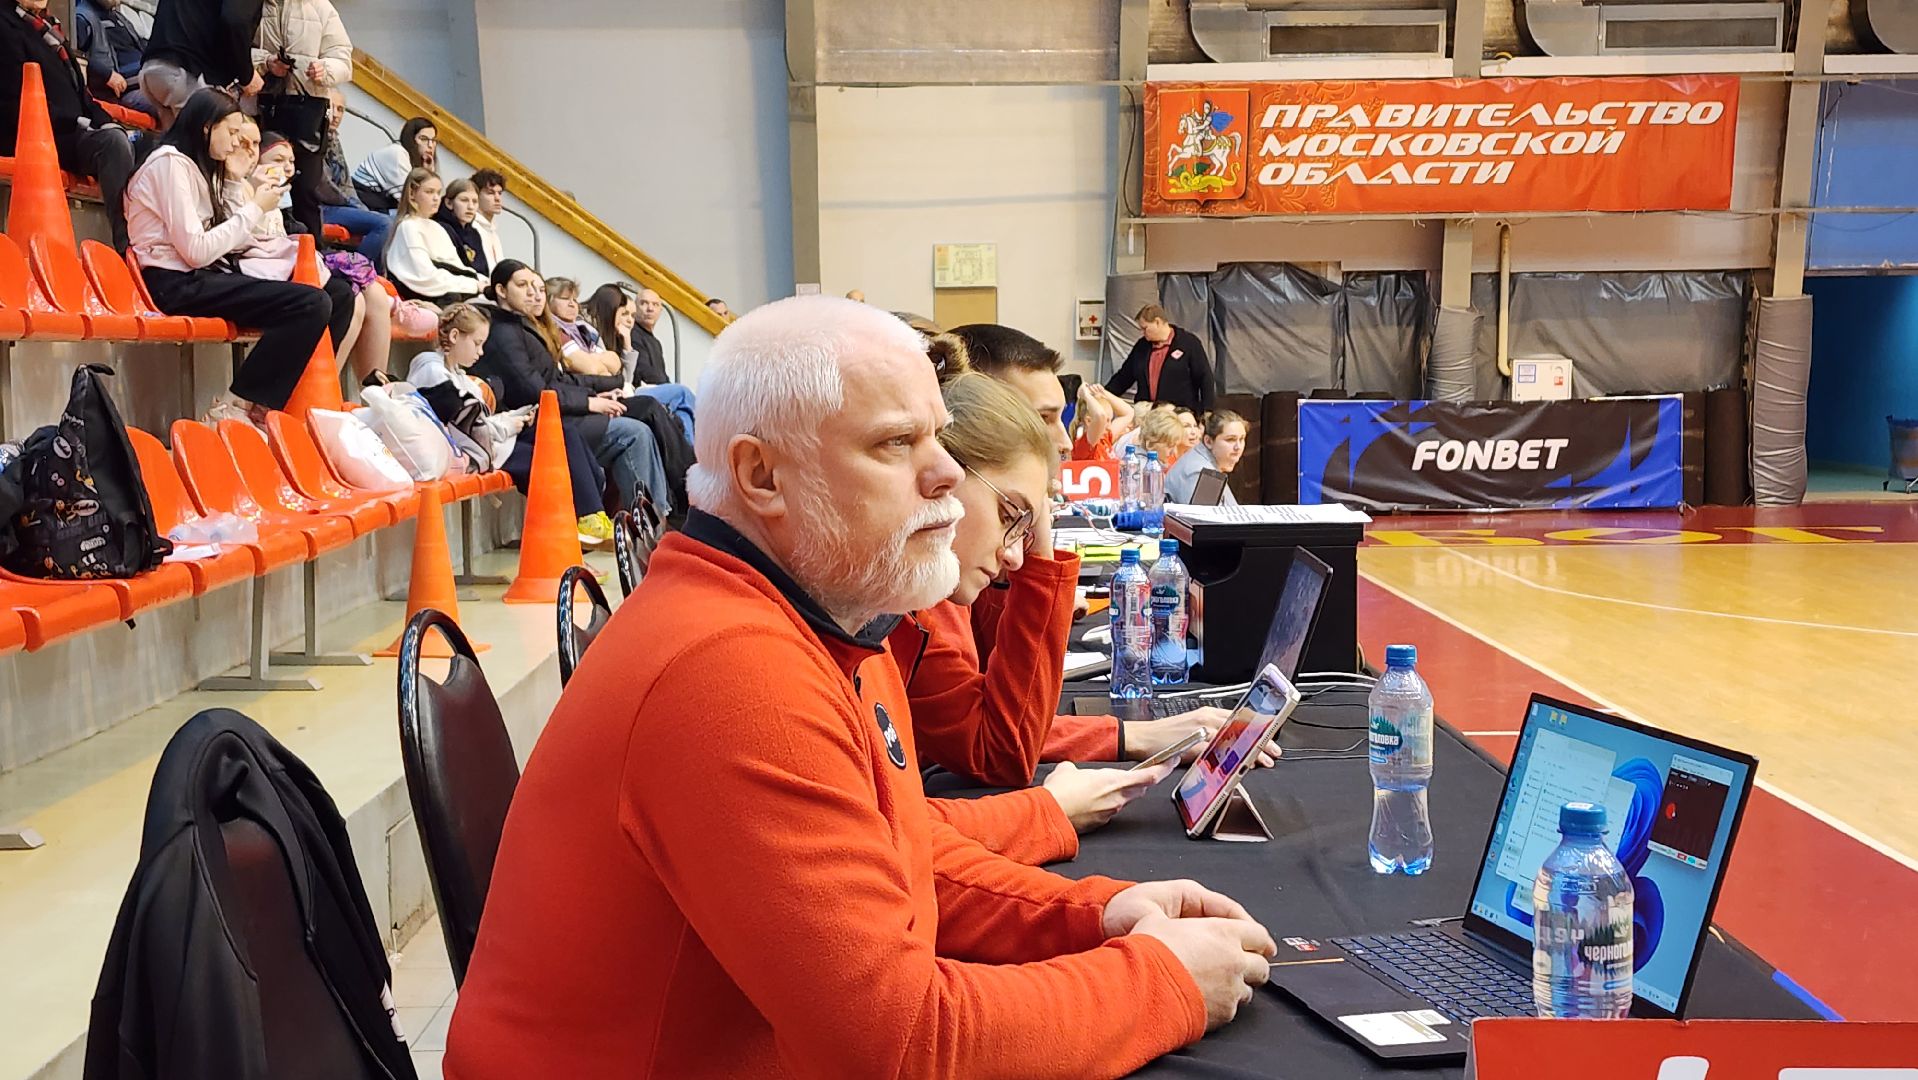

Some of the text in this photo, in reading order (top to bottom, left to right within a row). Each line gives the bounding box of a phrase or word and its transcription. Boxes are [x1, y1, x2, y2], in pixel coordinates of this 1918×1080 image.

[1259, 101, 1725, 128] ПРАВИТЕЛЬСТВО
[1258, 127, 1626, 157] МОСКОВСКОЙ
[1257, 161, 1515, 186] ОБЛАСТИ
[1411, 438, 1569, 472] FONBET
[1062, 465, 1112, 496] 5
